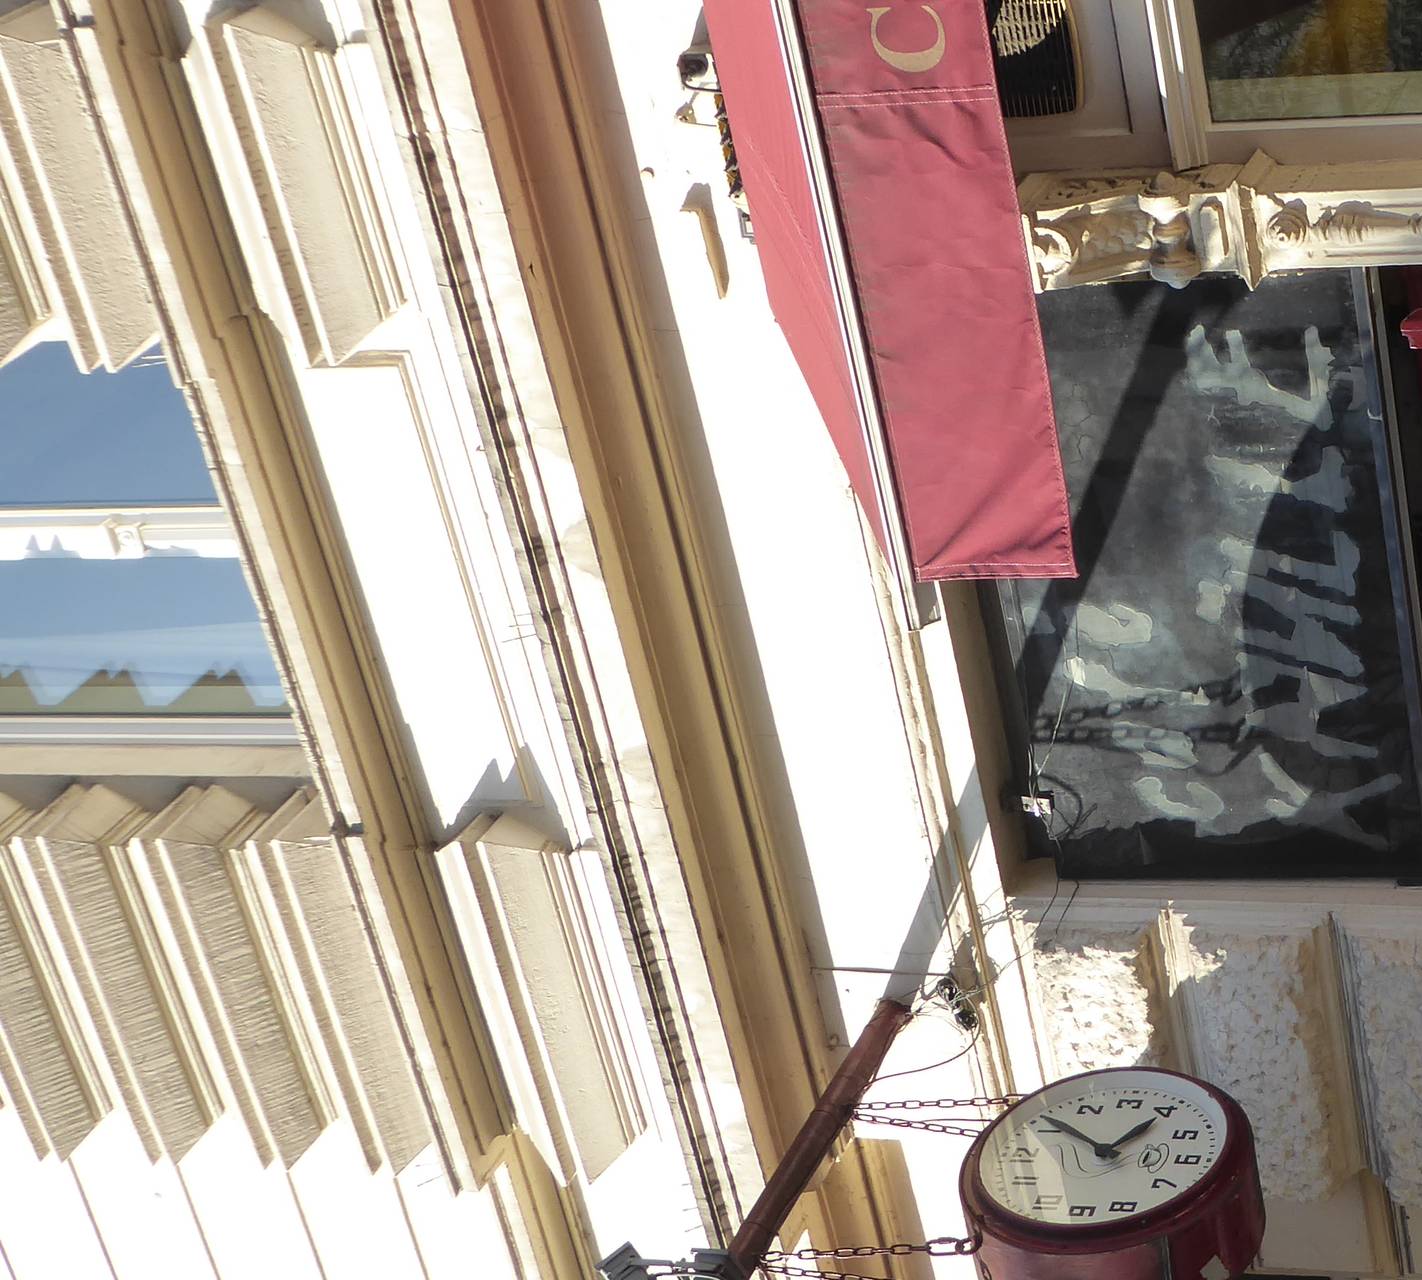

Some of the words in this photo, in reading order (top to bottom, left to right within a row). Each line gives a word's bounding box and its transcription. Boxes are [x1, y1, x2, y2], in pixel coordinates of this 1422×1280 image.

[866, 6, 947, 73] C
[1077, 1103, 1104, 1115] 2
[1116, 1098, 1143, 1110] 3
[1152, 1105, 1178, 1119] 4
[1172, 1128, 1199, 1141] 5
[1011, 1146, 1039, 1162] 12
[1174, 1152, 1201, 1166] 6
[1011, 1175, 1039, 1186] 11
[1151, 1178, 1177, 1190] 7
[1032, 1194, 1064, 1211] 10
[1108, 1200, 1138, 1213] 8
[1069, 1205, 1096, 1217] 9
